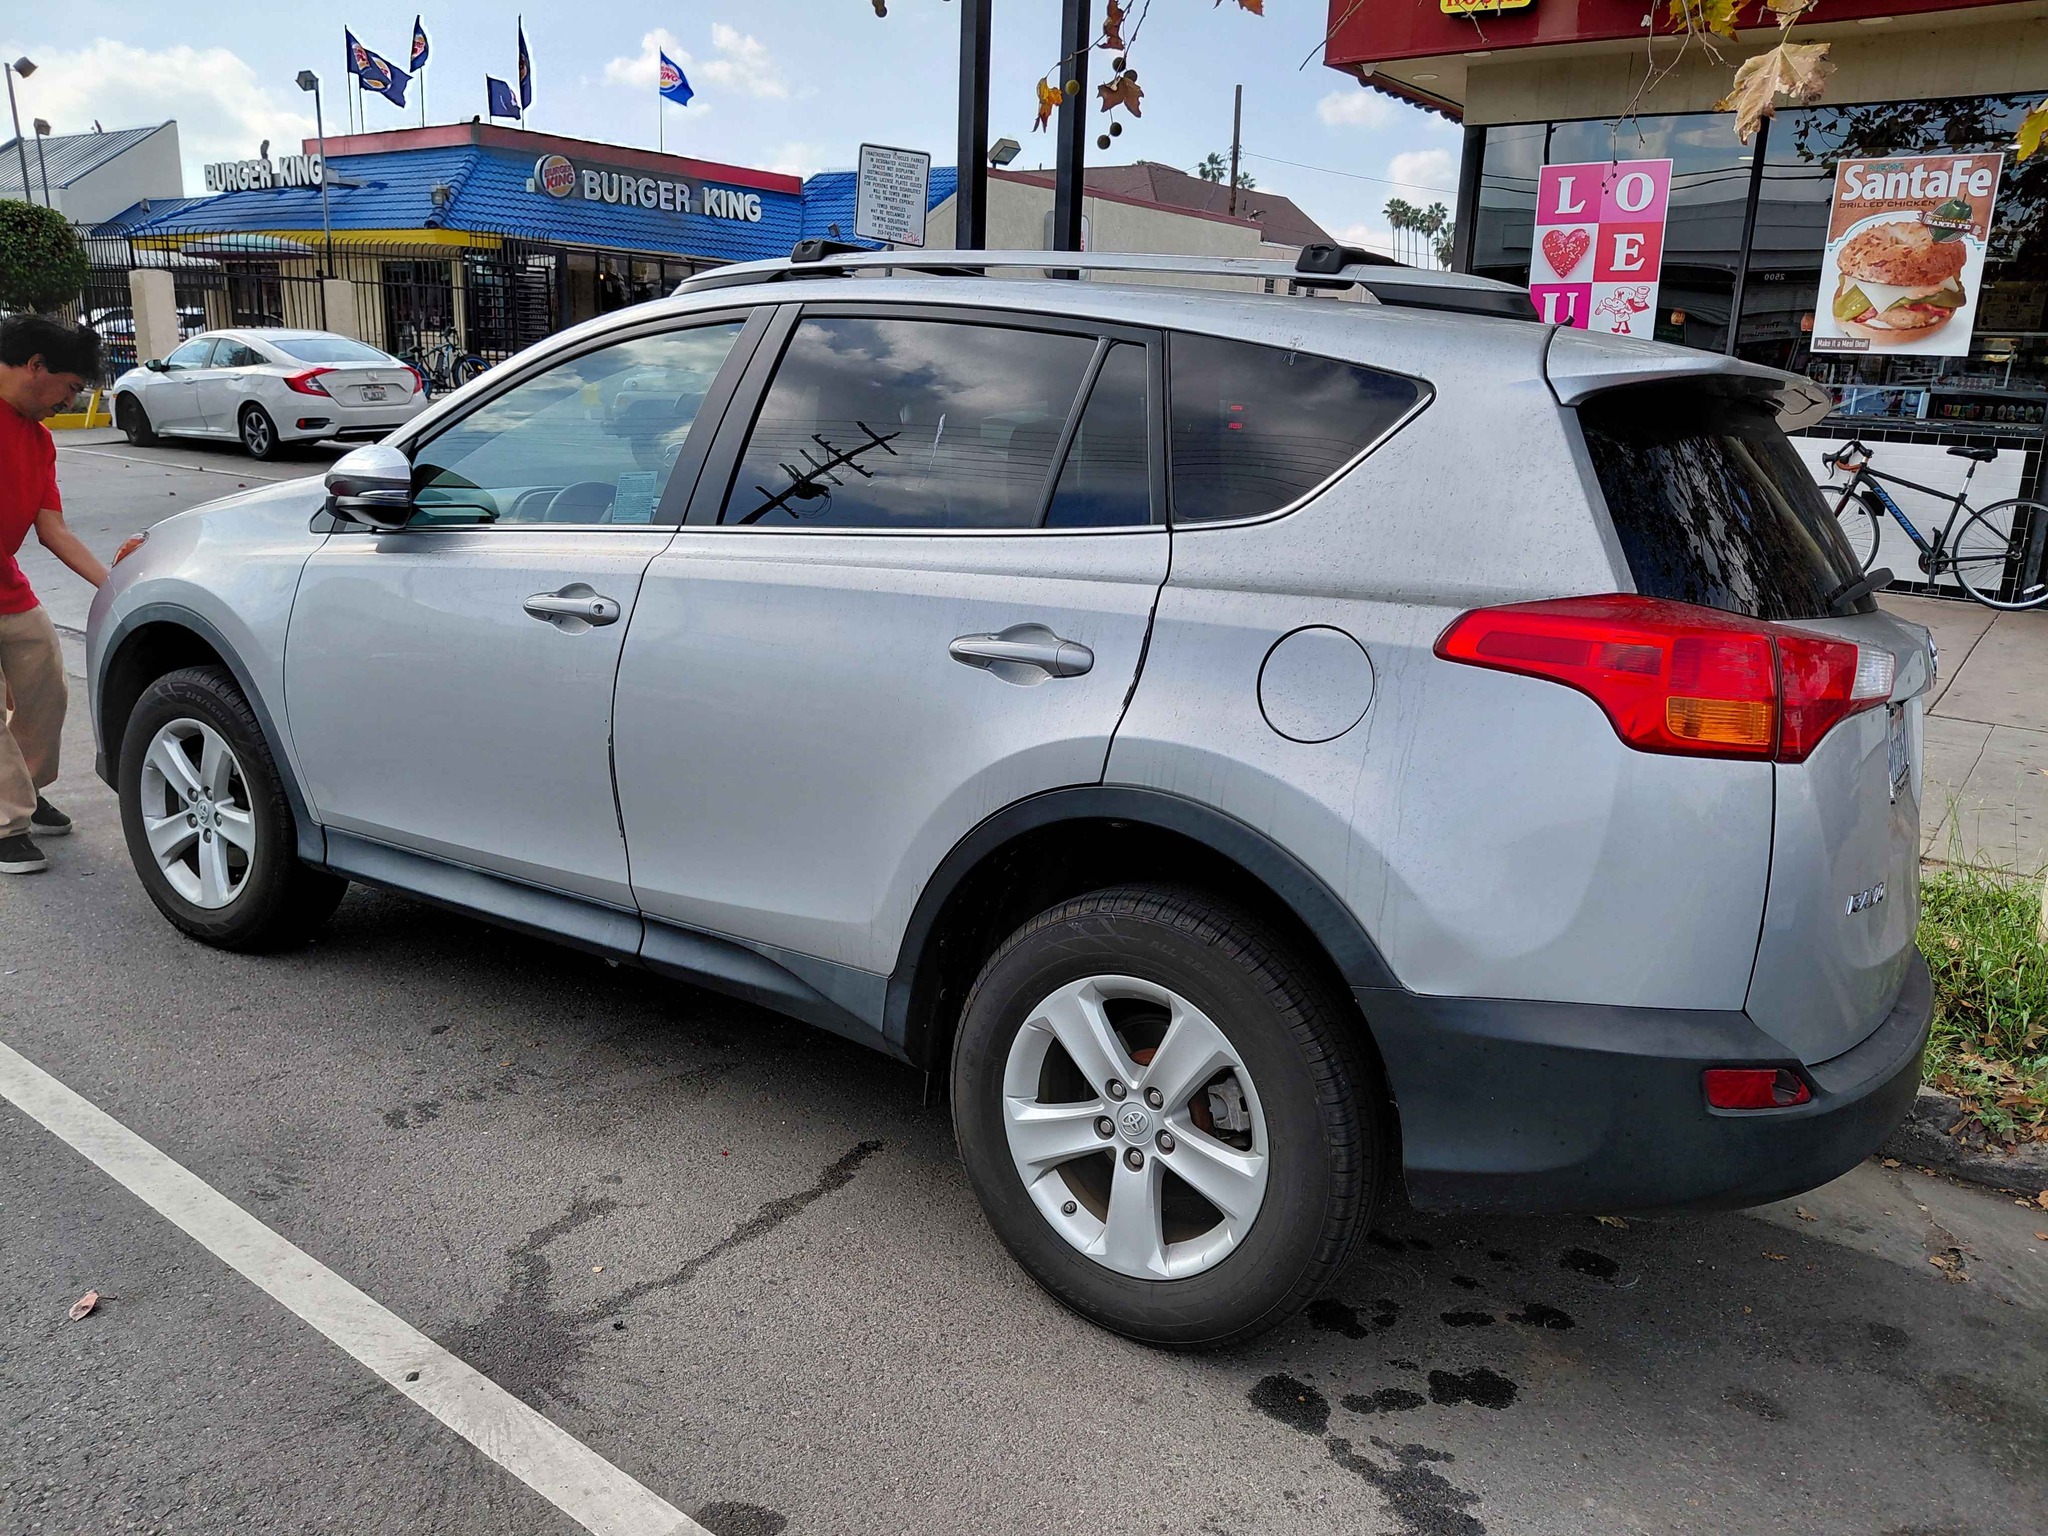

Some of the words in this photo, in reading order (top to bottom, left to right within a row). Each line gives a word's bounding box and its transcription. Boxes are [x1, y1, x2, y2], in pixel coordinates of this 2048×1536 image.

[204, 158, 272, 192] BURGER
[279, 154, 322, 187] KING
[544, 164, 572, 177] BURGER
[546, 172, 574, 190] KING
[582, 170, 690, 212] BURGER
[703, 187, 762, 222] KING
[1888, 200, 1936, 208] CHICKEN
[1926, 220, 1956, 228] SANTA
